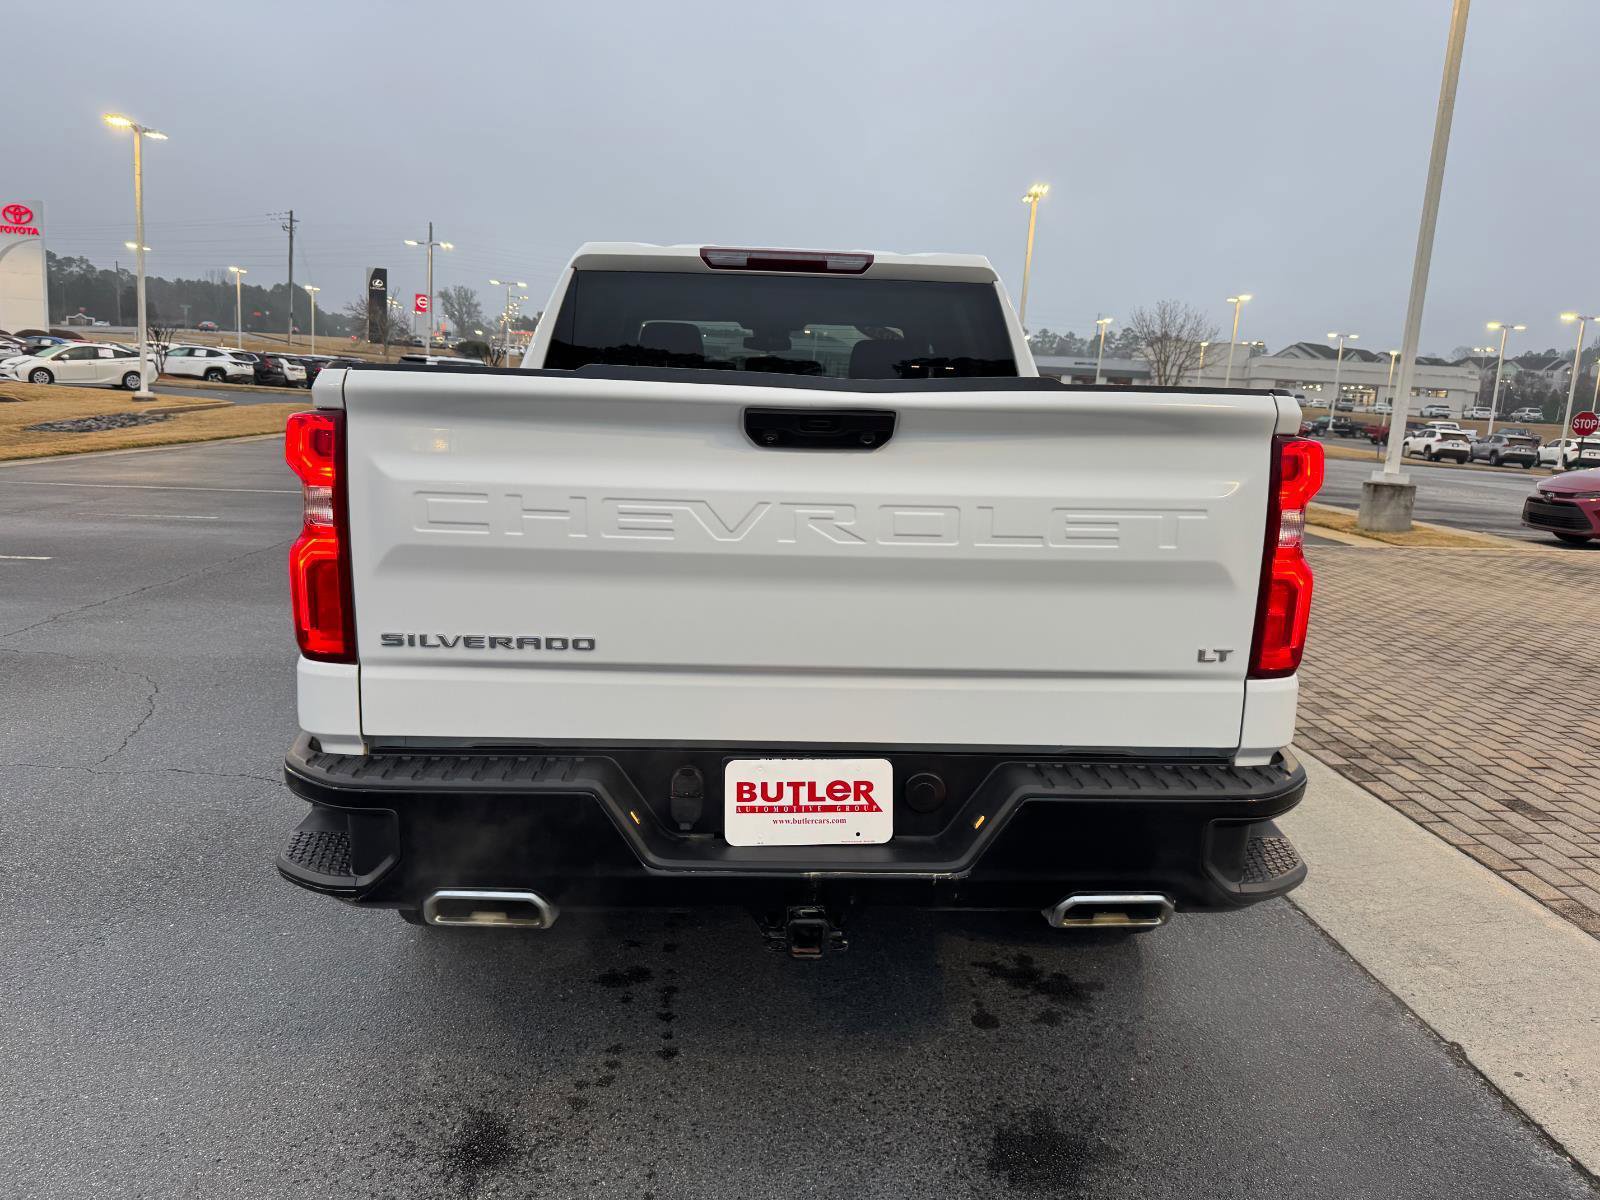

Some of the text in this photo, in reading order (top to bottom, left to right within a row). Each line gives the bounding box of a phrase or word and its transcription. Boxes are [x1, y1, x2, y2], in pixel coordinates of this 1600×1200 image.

[0, 225, 40, 235] TOYOTA
[1573, 418, 1597, 429] STOP
[413, 491, 1208, 548] CHEVROLET
[381, 633, 596, 650] SILVERADO
[1198, 649, 1234, 663] LT
